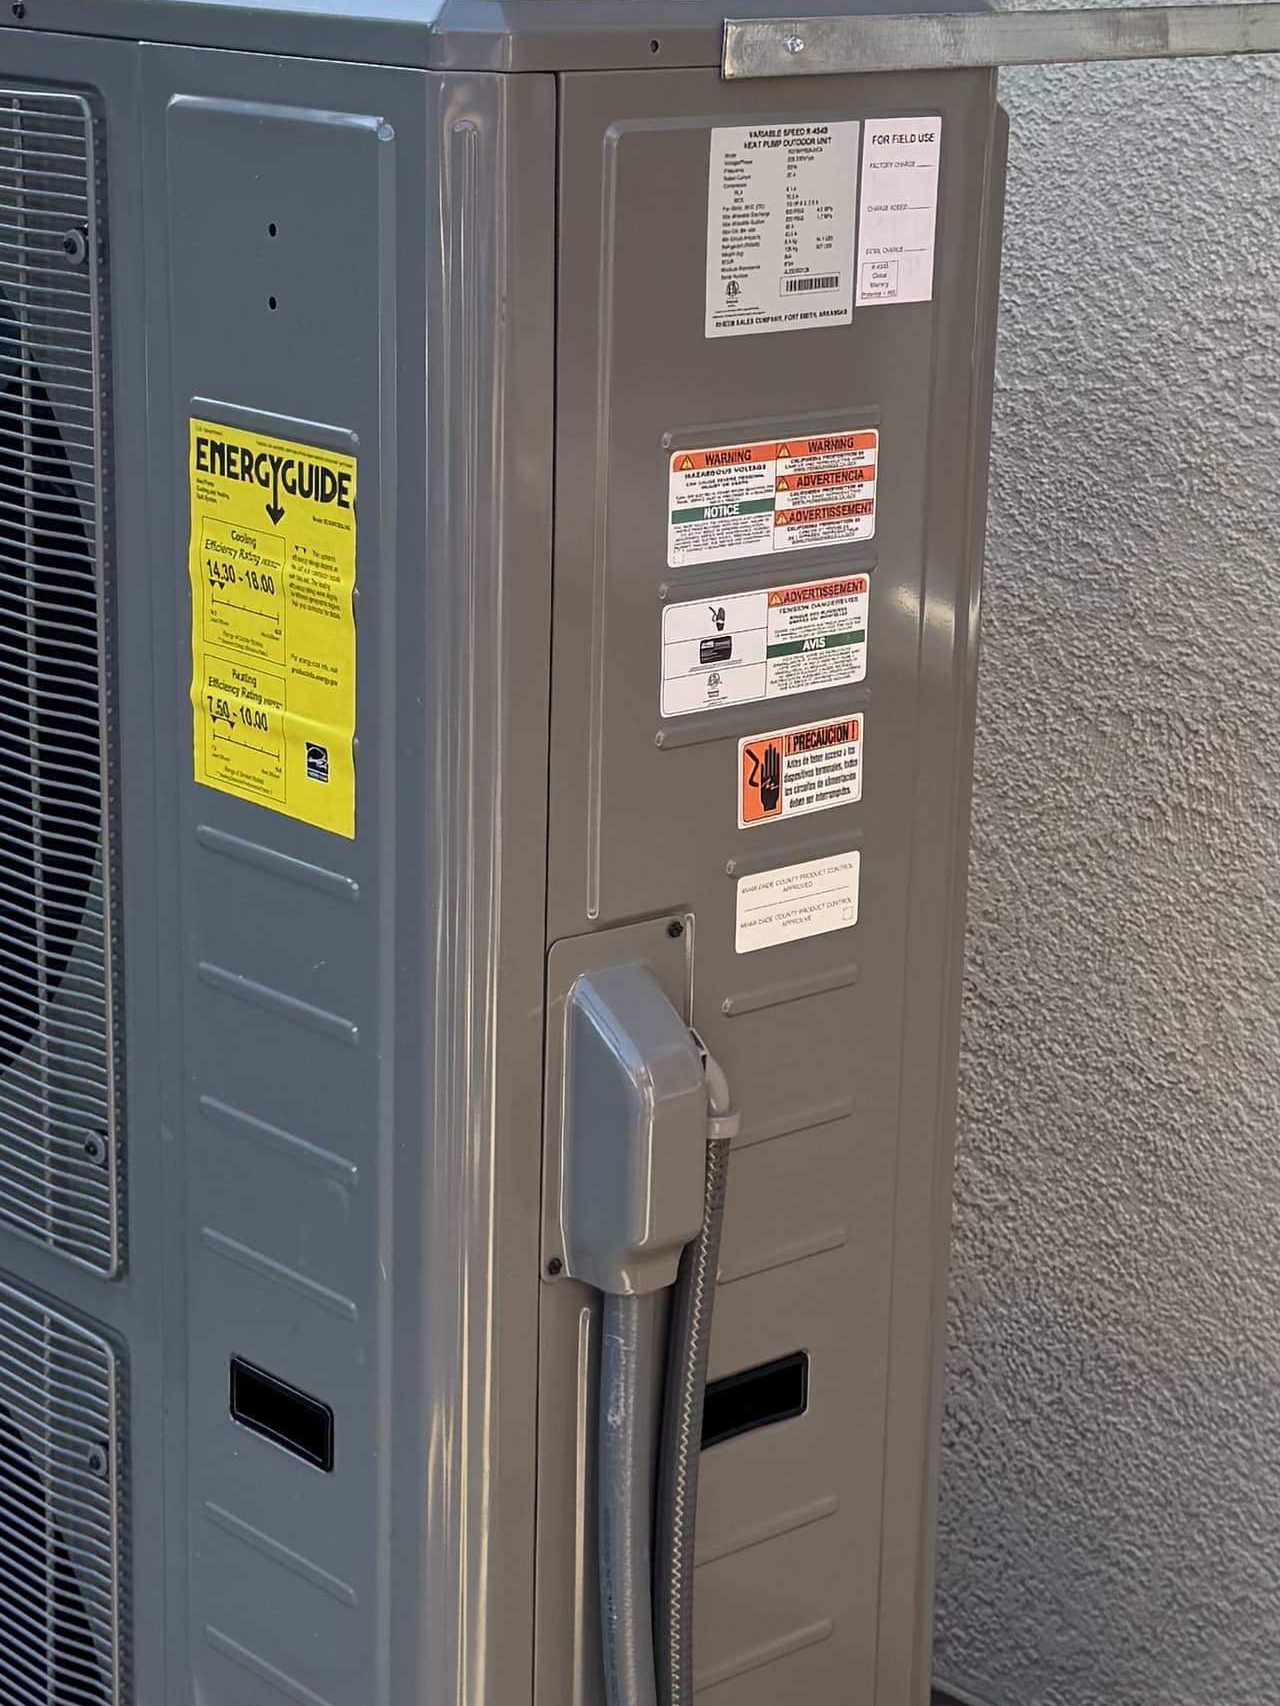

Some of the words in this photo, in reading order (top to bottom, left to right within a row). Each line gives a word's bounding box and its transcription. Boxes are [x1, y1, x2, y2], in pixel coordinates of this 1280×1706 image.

[763, 139, 782, 148] PUMP
[872, 134, 890, 145] FOR
[892, 134, 916, 144] FIELD
[918, 133, 936, 143] USE
[808, 437, 854, 453] WARNING
[705, 449, 752, 466] WARNING
[196, 436, 352, 510] ENERGYGUIDE
[685, 468, 732, 479] HAZARDOUS
[734, 464, 767, 473] VOLTAGE
[797, 469, 864, 487] ADVERTENCIA
[703, 504, 740, 520] NOTICE
[788, 501, 872, 523] ADVERTISSEMENT
[231, 530, 257, 550] Cooling
[205, 538, 238, 560] Efficiency
[239, 548, 261, 566] Rating
[207, 559, 236, 584] 14.30
[245, 569, 275, 595] 18.00
[784, 580, 863, 603] ADVERTISSEMENT
[802, 637, 826, 651] AVIS
[208, 676, 240, 697] Efficiency
[241, 686, 262, 704] Rating
[207, 695, 230, 719] 7.50
[240, 705, 268, 732] 10.00
